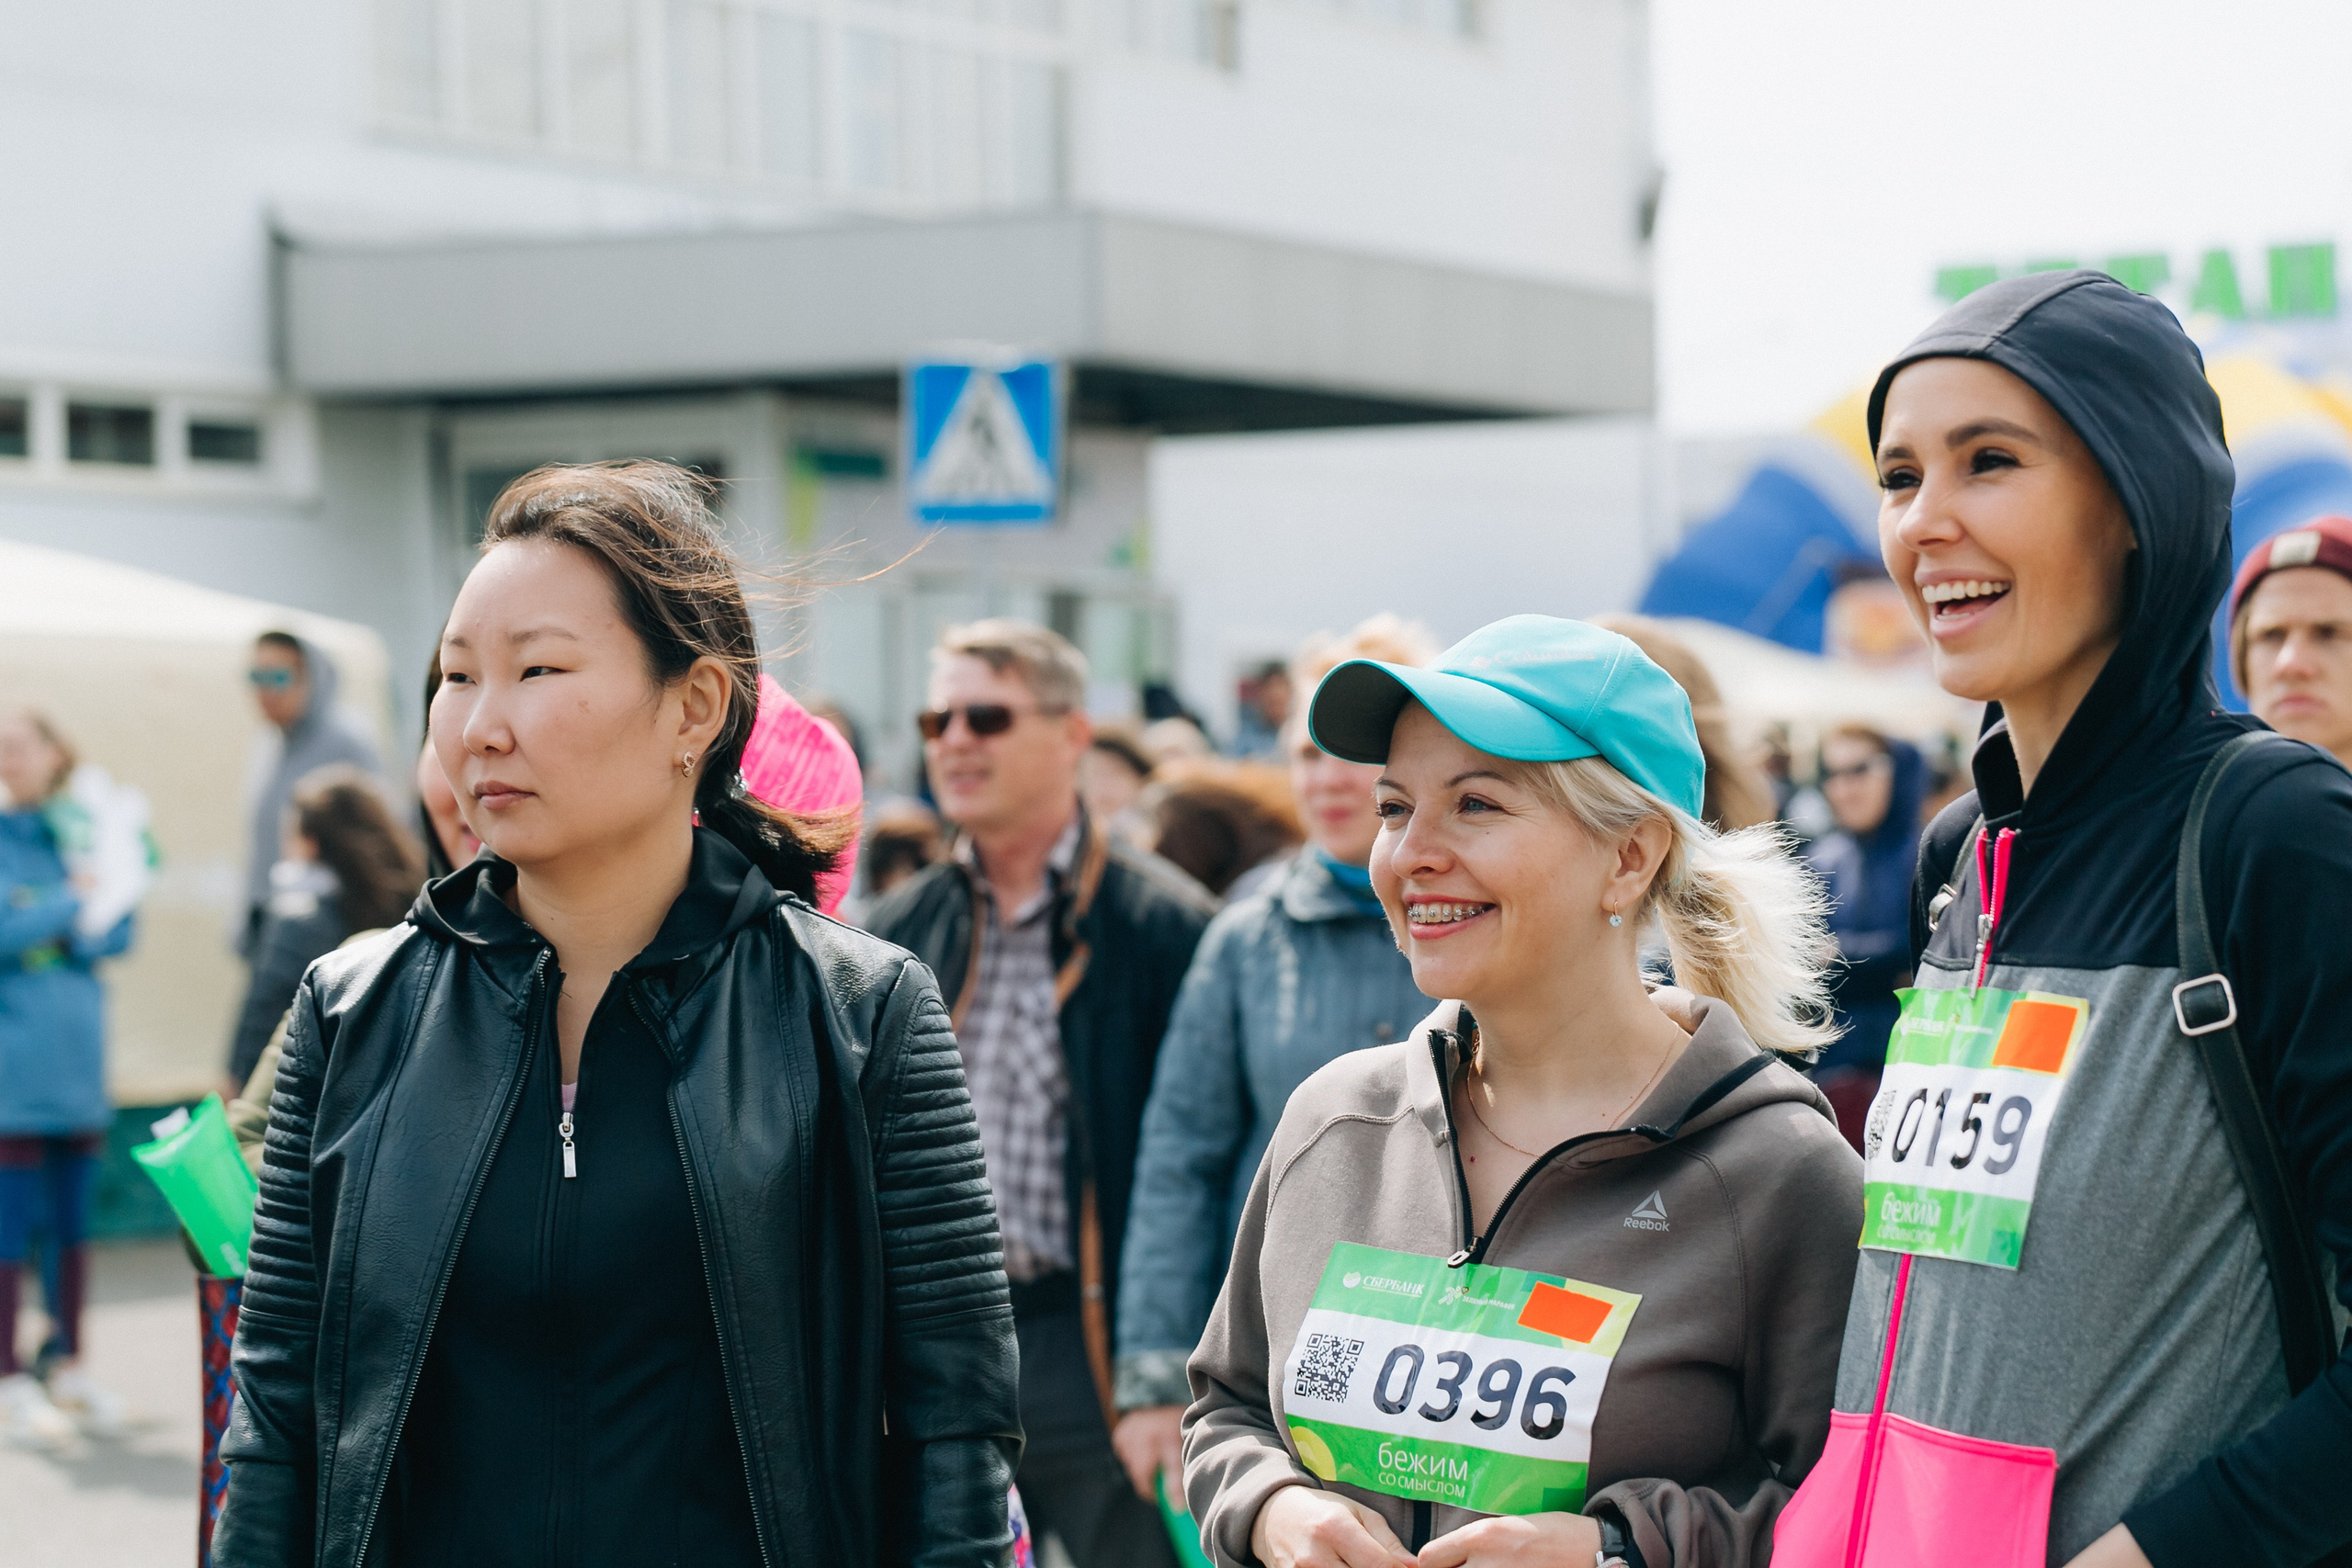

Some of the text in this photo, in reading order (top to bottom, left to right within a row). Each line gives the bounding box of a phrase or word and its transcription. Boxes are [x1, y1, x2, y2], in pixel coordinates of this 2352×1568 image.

[1891, 1088, 2033, 1176] 0159
[1623, 1217, 1670, 1232] Reebok
[1363, 1275, 1425, 1295] СБЕРБАНК
[1372, 1343, 1577, 1440] 0396
[1378, 1442, 1468, 1482] бежим
